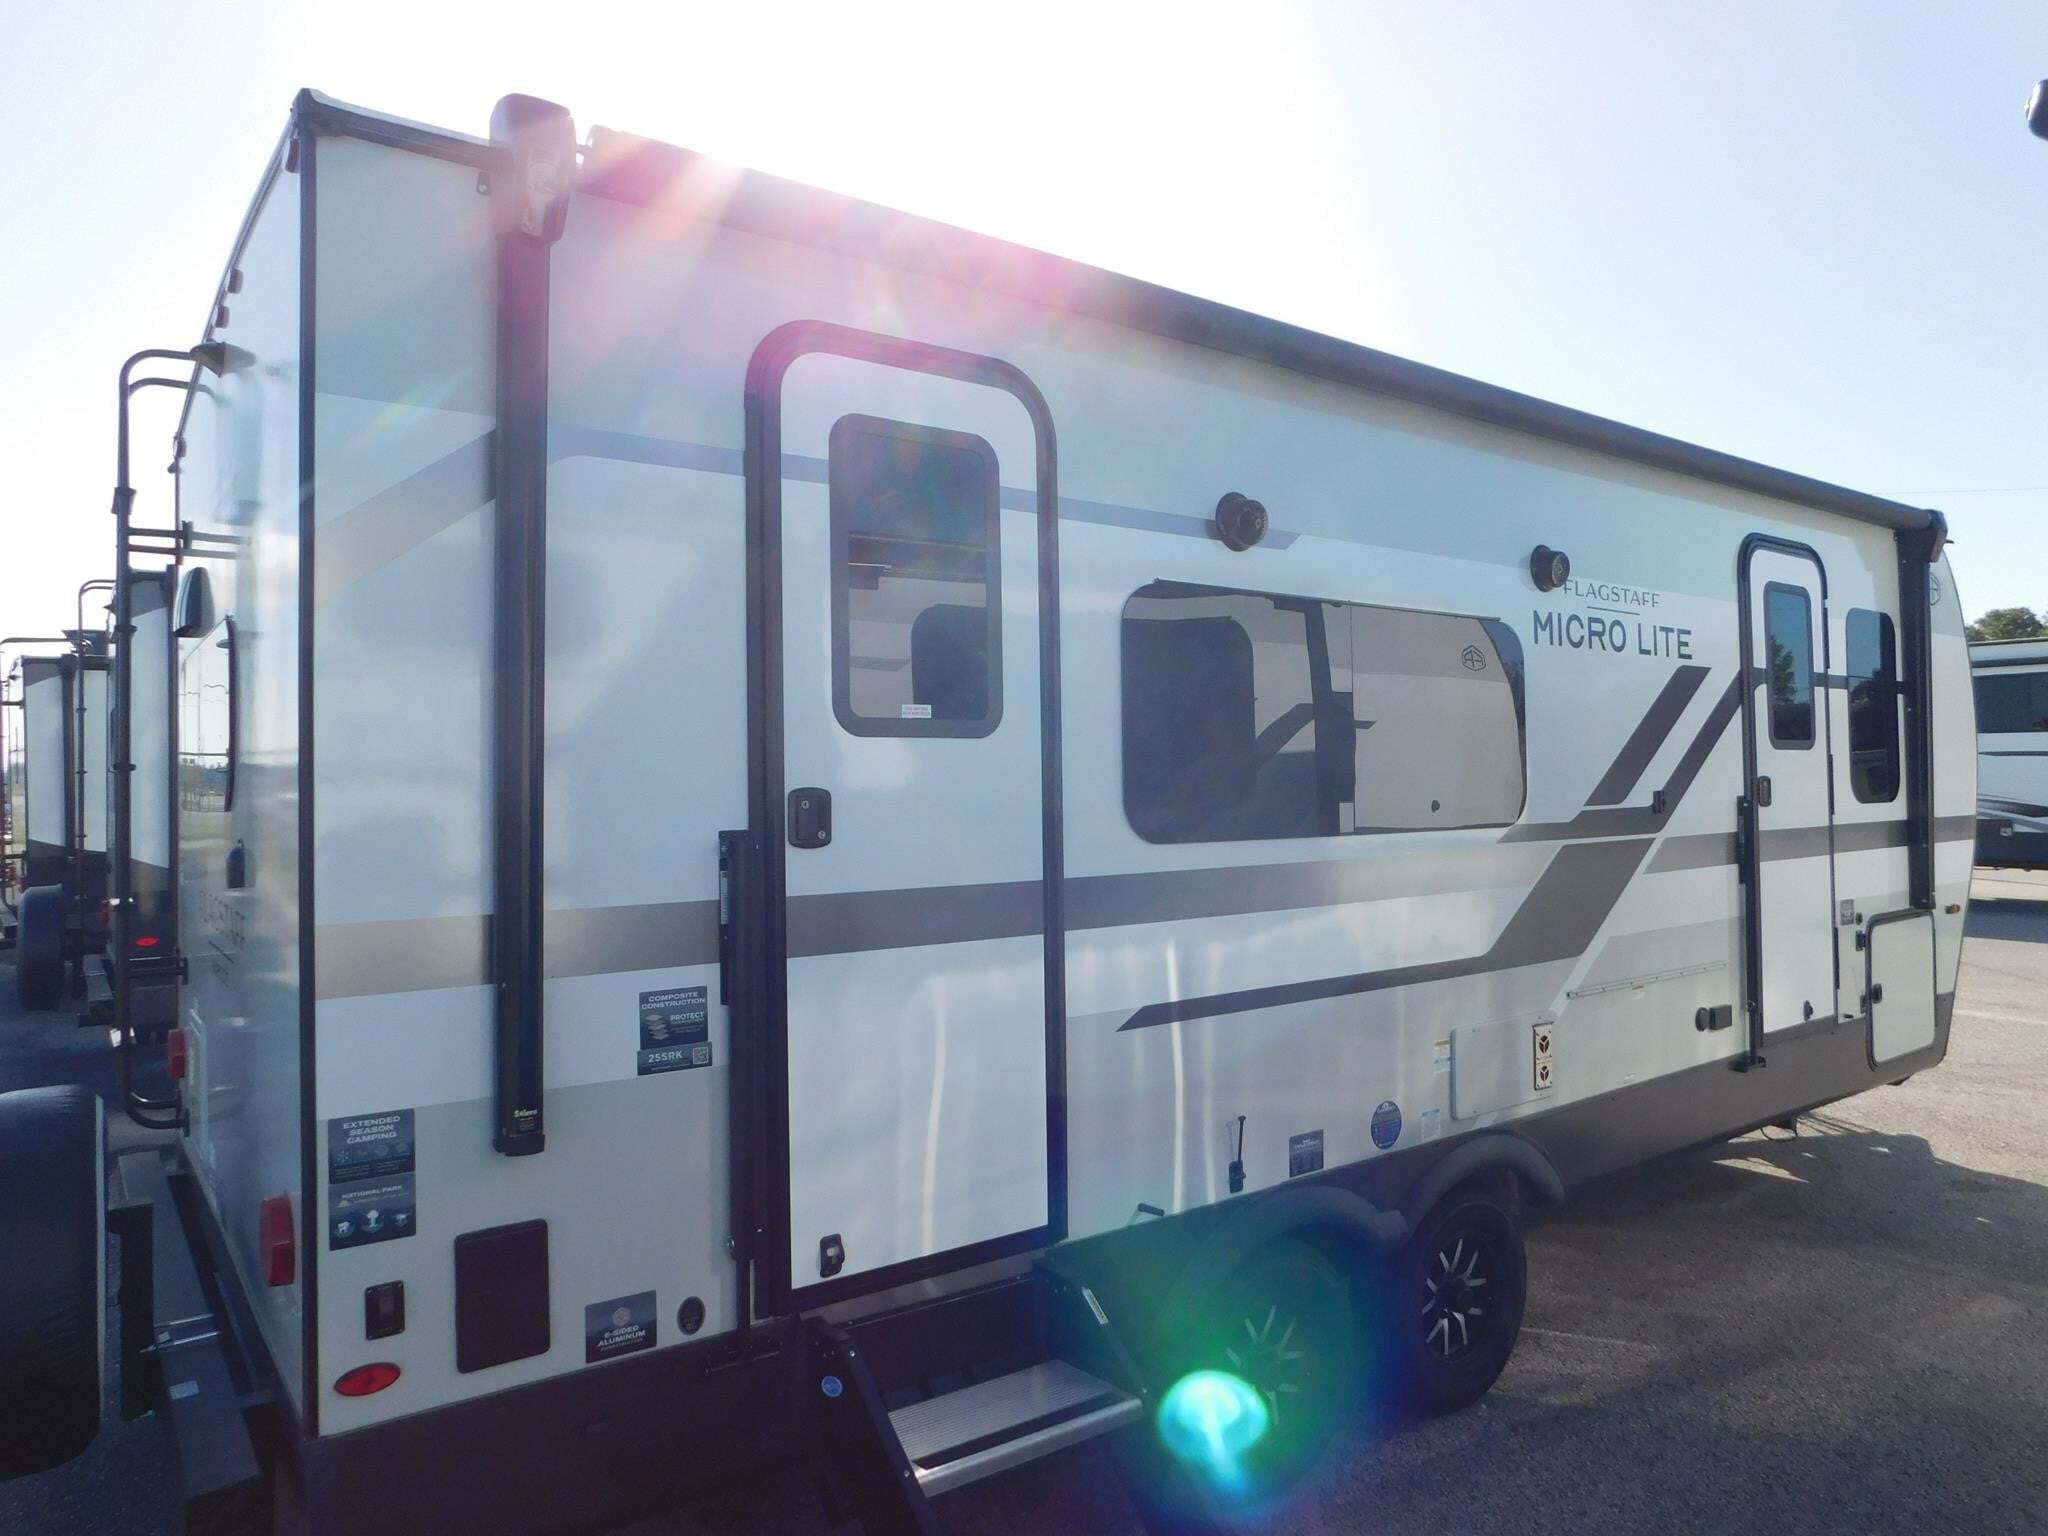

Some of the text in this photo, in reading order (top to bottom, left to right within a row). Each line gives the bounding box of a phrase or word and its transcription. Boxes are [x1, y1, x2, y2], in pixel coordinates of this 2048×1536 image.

[1564, 579, 1660, 607] FLAGSTAFF
[1533, 610, 1693, 660] MICRO LITE
[648, 991, 699, 1002] COMPOSITE
[641, 998, 706, 1010] CONSTRUCTION
[343, 1115, 401, 1129] EXTENDED
[350, 1124, 394, 1136] SEASON
[346, 1131, 397, 1144] CAMPING
[598, 1329, 647, 1347] ALUMINUM
